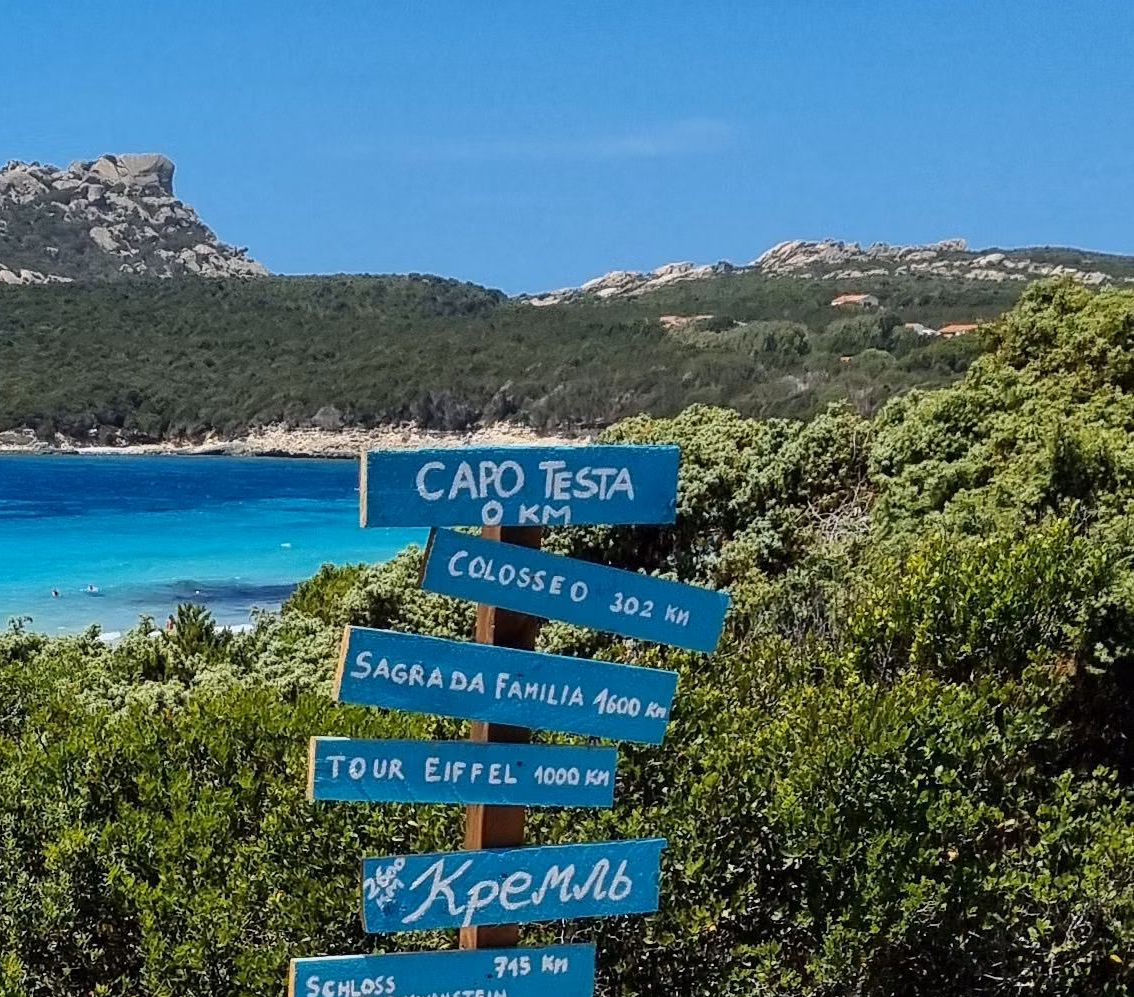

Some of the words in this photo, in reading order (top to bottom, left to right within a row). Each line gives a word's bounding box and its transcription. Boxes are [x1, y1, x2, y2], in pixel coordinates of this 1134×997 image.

[416, 460, 525, 501] CAPO
[481, 500, 504, 526] 0
[518, 503, 572, 526] KM
[448, 551, 589, 603] COLOSSEO
[609, 592, 654, 618] 302
[495, 672, 584, 706] FAMILIA
[593, 688, 641, 717] 1600
[326, 755, 405, 781] TOUR
[425, 757, 518, 785] EIFFEL
[534, 766, 580, 785] 1000
[401, 856, 632, 927] Кремль
[494, 956, 531, 979] 715
